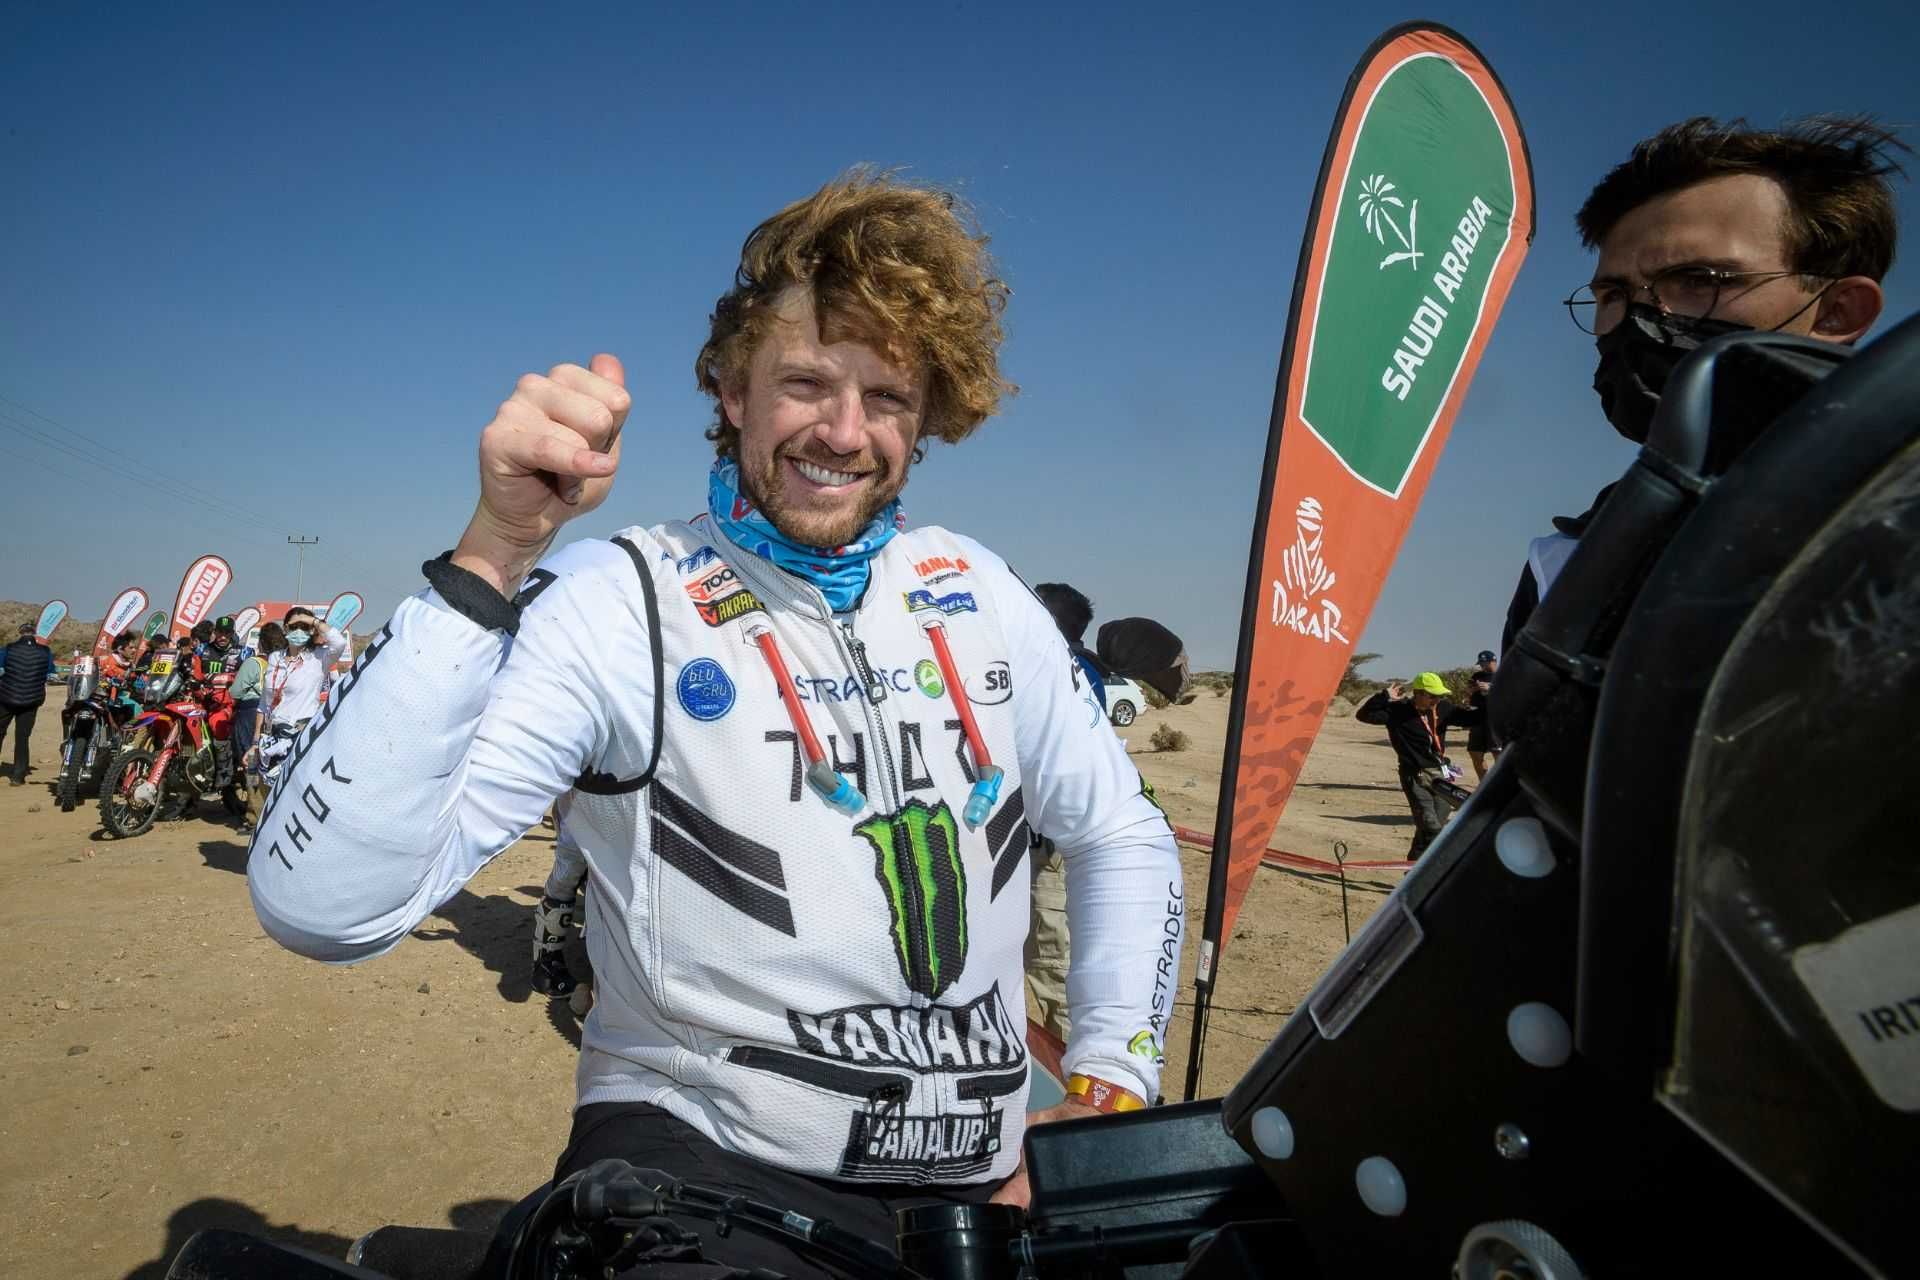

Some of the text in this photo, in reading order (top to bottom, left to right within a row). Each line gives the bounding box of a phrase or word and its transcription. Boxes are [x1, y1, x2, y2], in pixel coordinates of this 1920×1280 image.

[1382, 195, 1492, 400] SAUDI ARABIA
[183, 566, 220, 621] MOTUL
[702, 568, 741, 592] TOO
[1273, 580, 1349, 645] DAKAR
[153, 662, 167, 673] 88
[985, 669, 1010, 691] SB
[1148, 881, 1184, 1031] ASTRADEC
[797, 990, 1023, 1068] YAMAHA
